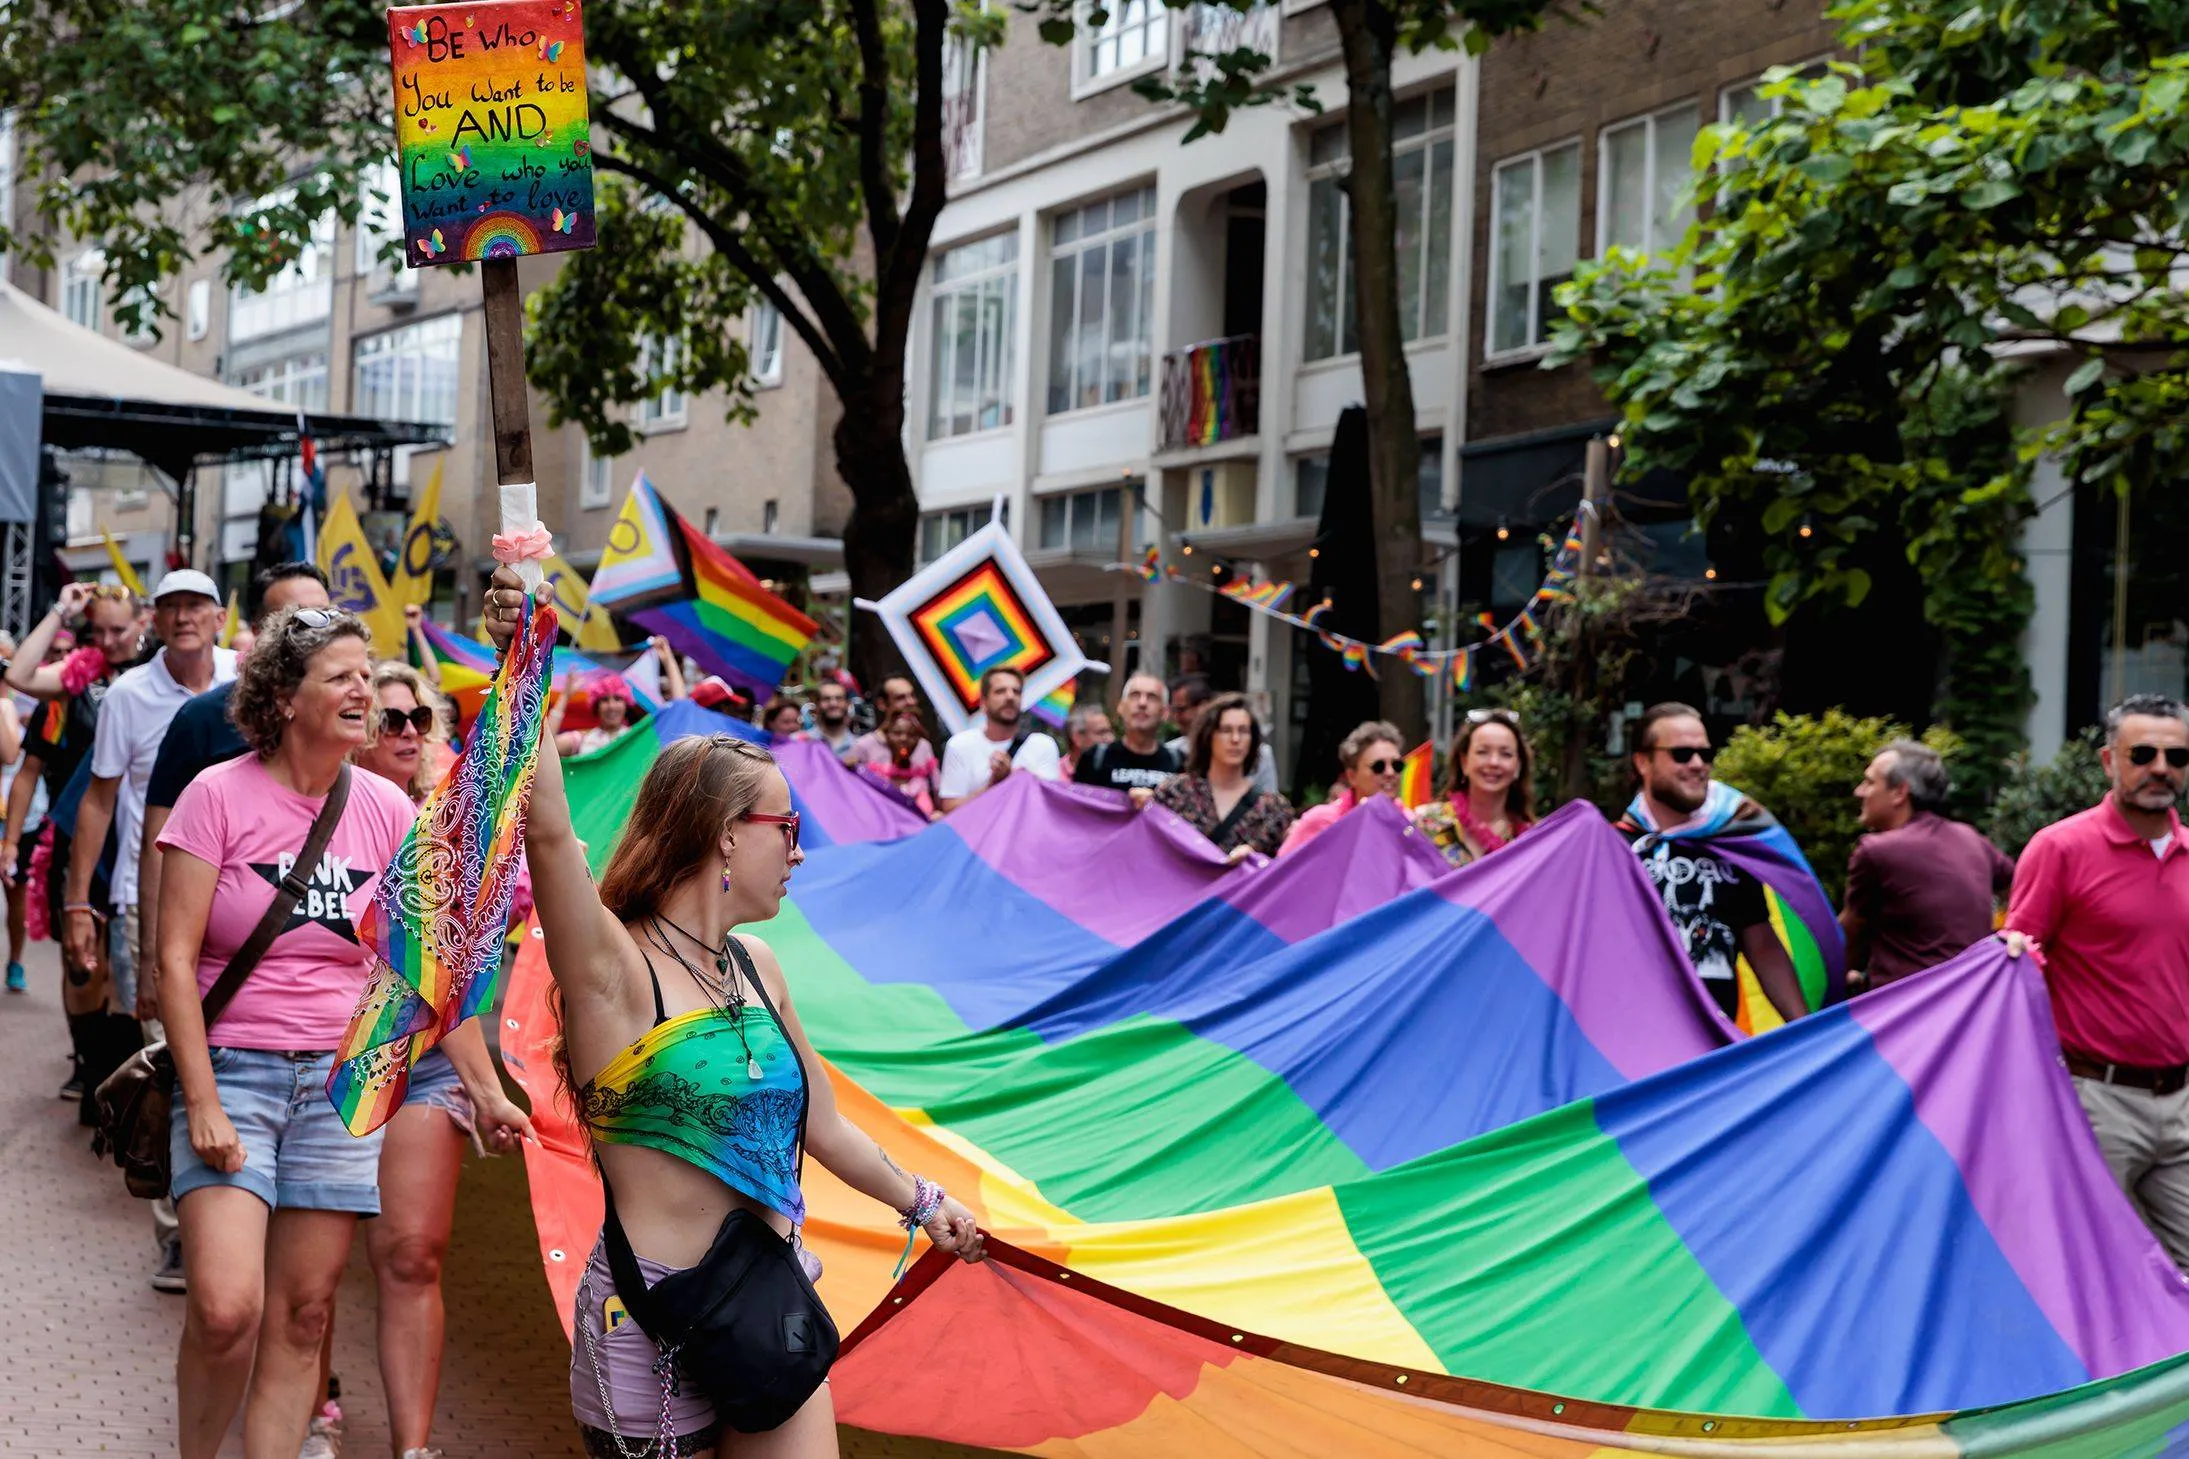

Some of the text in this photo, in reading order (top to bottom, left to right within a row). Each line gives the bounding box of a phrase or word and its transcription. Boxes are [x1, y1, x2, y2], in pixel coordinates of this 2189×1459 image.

[426, 15, 465, 63] BE
[402, 72, 454, 118] You
[536, 73, 555, 93] to
[559, 71, 576, 93] be
[450, 103, 547, 149] AND
[411, 153, 481, 194] Love
[559, 156, 592, 178] you
[488, 188, 515, 207] to
[527, 180, 583, 211] love
[278, 851, 354, 892] PNK
